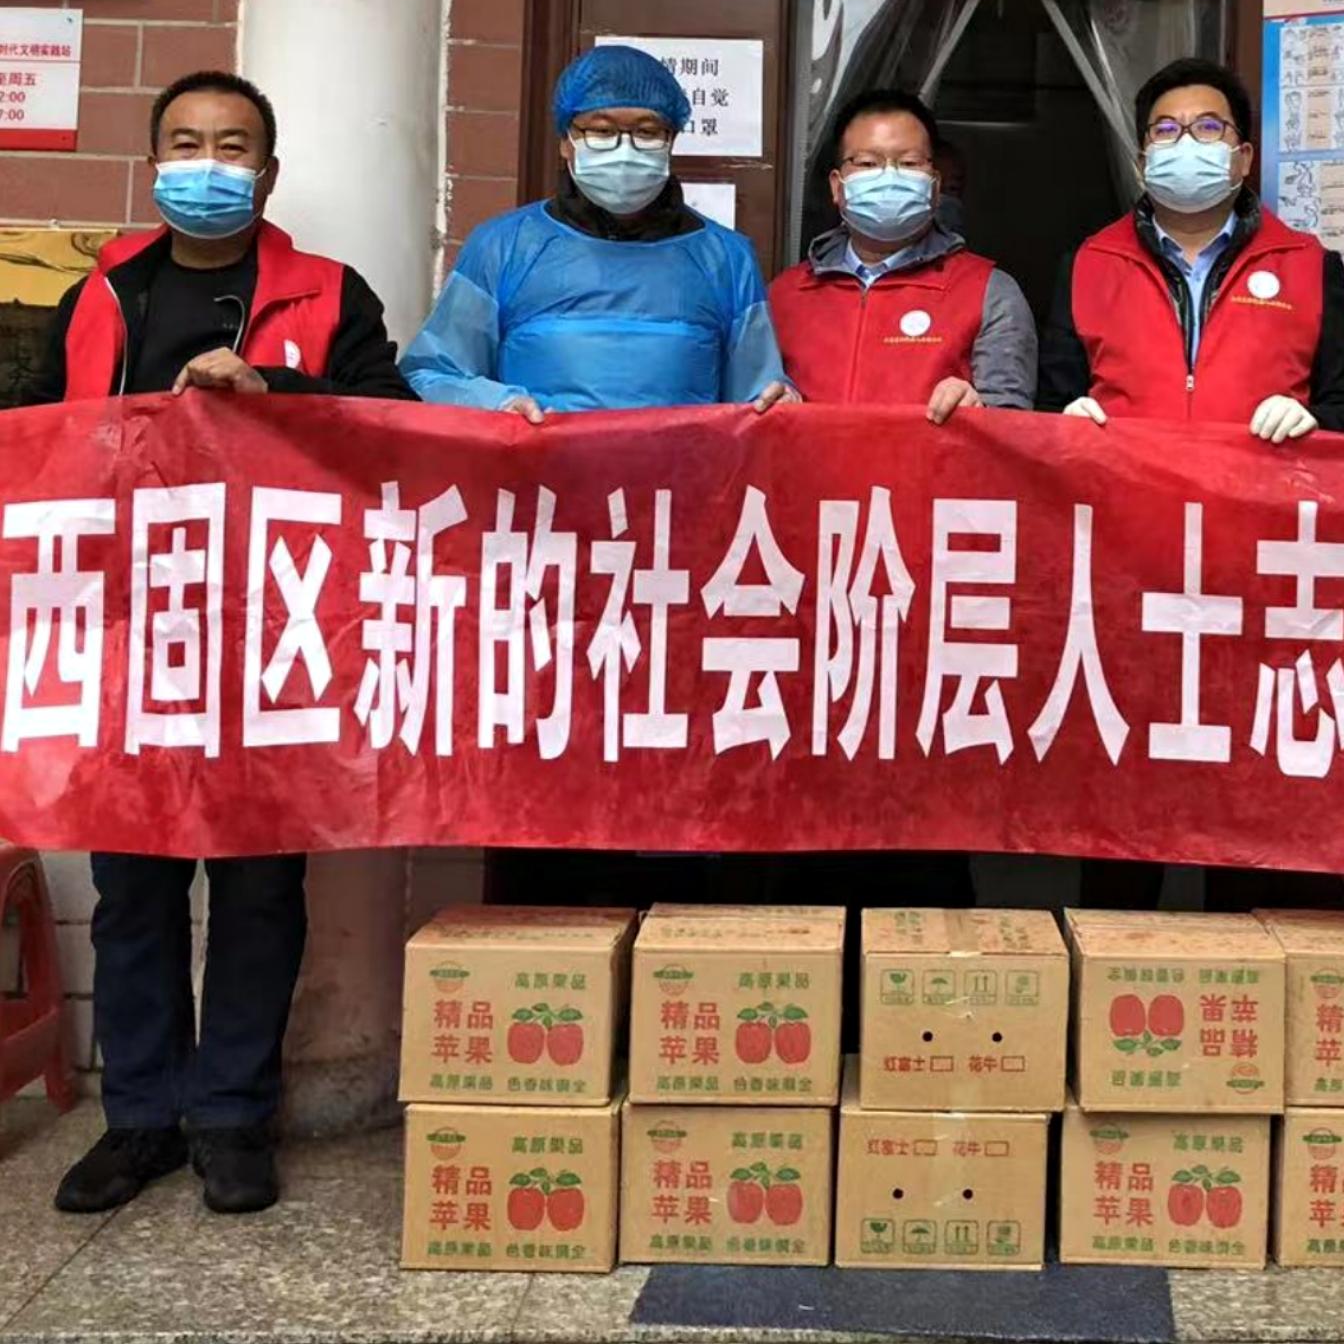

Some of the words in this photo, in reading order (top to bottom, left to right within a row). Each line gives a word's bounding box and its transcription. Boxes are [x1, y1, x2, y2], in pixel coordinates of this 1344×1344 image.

[683, 87, 729, 107] 自觉
[434, 999, 494, 1030] 精品
[661, 1000, 720, 1030] 精品
[1199, 993, 1260, 1023] 苹果
[431, 1034, 493, 1064] 苹果
[658, 1035, 720, 1065] 苹果
[1199, 1029, 1260, 1059] 精品
[884, 1055, 926, 1073] 红富士
[431, 1163, 493, 1195] 精品
[652, 1159, 713, 1190] 精品
[1094, 1160, 1154, 1192] 精品
[430, 1201, 492, 1232] 苹果
[651, 1194, 713, 1226] 苹果
[1094, 1196, 1155, 1228] 苹果
